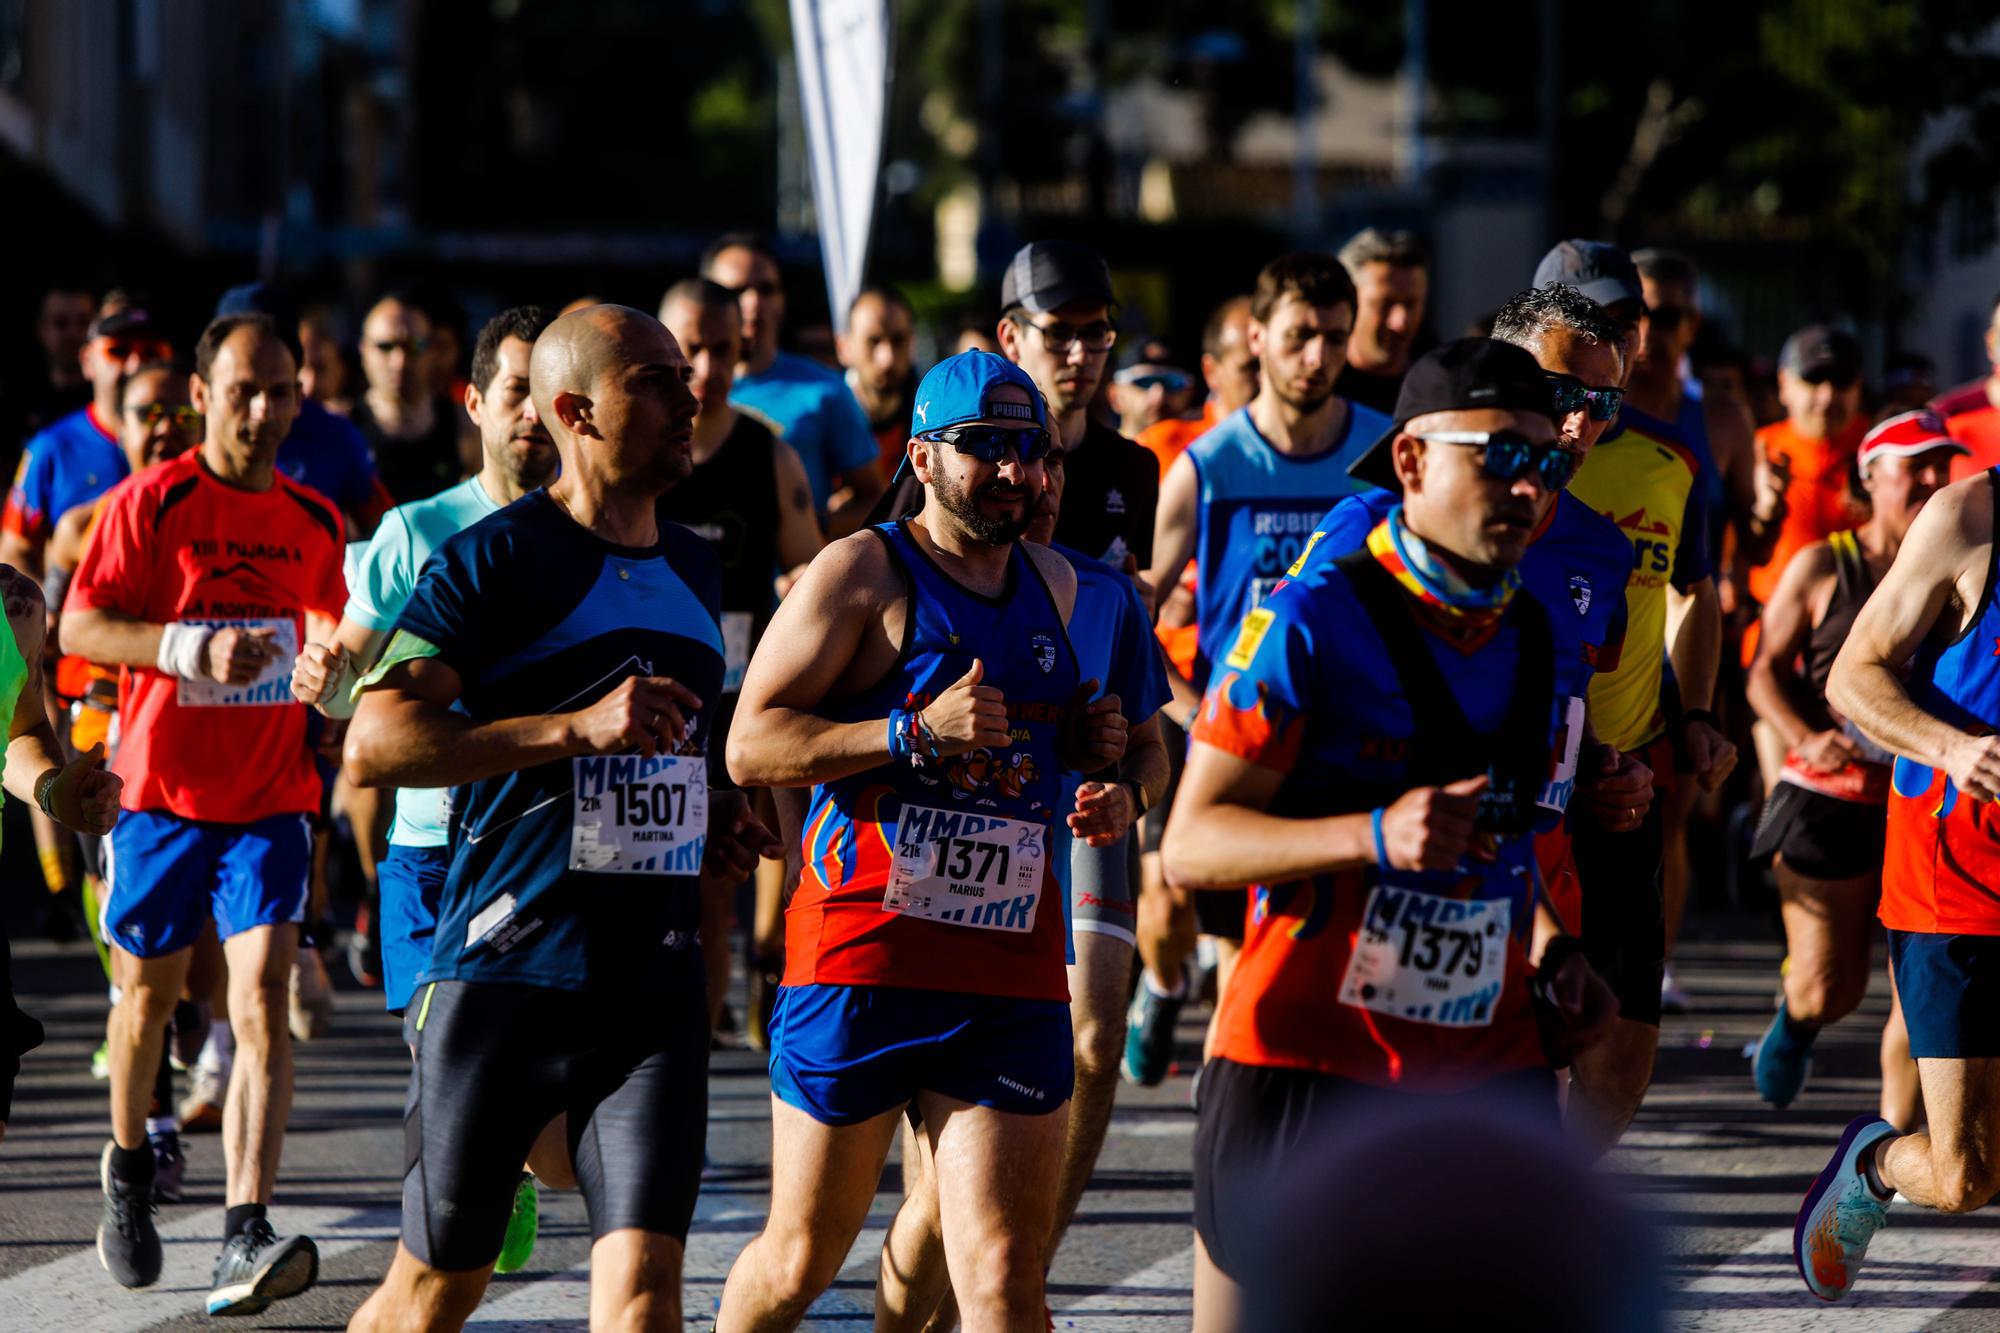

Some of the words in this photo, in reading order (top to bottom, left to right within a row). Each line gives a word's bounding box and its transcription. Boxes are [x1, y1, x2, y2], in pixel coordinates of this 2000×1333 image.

[992, 403, 1032, 419] PUMA
[610, 783, 687, 827] 1507
[632, 831, 675, 842] MARTINA
[929, 836, 1010, 885] 1371
[949, 883, 985, 898] MARIUS
[1398, 921, 1482, 978] 1379
